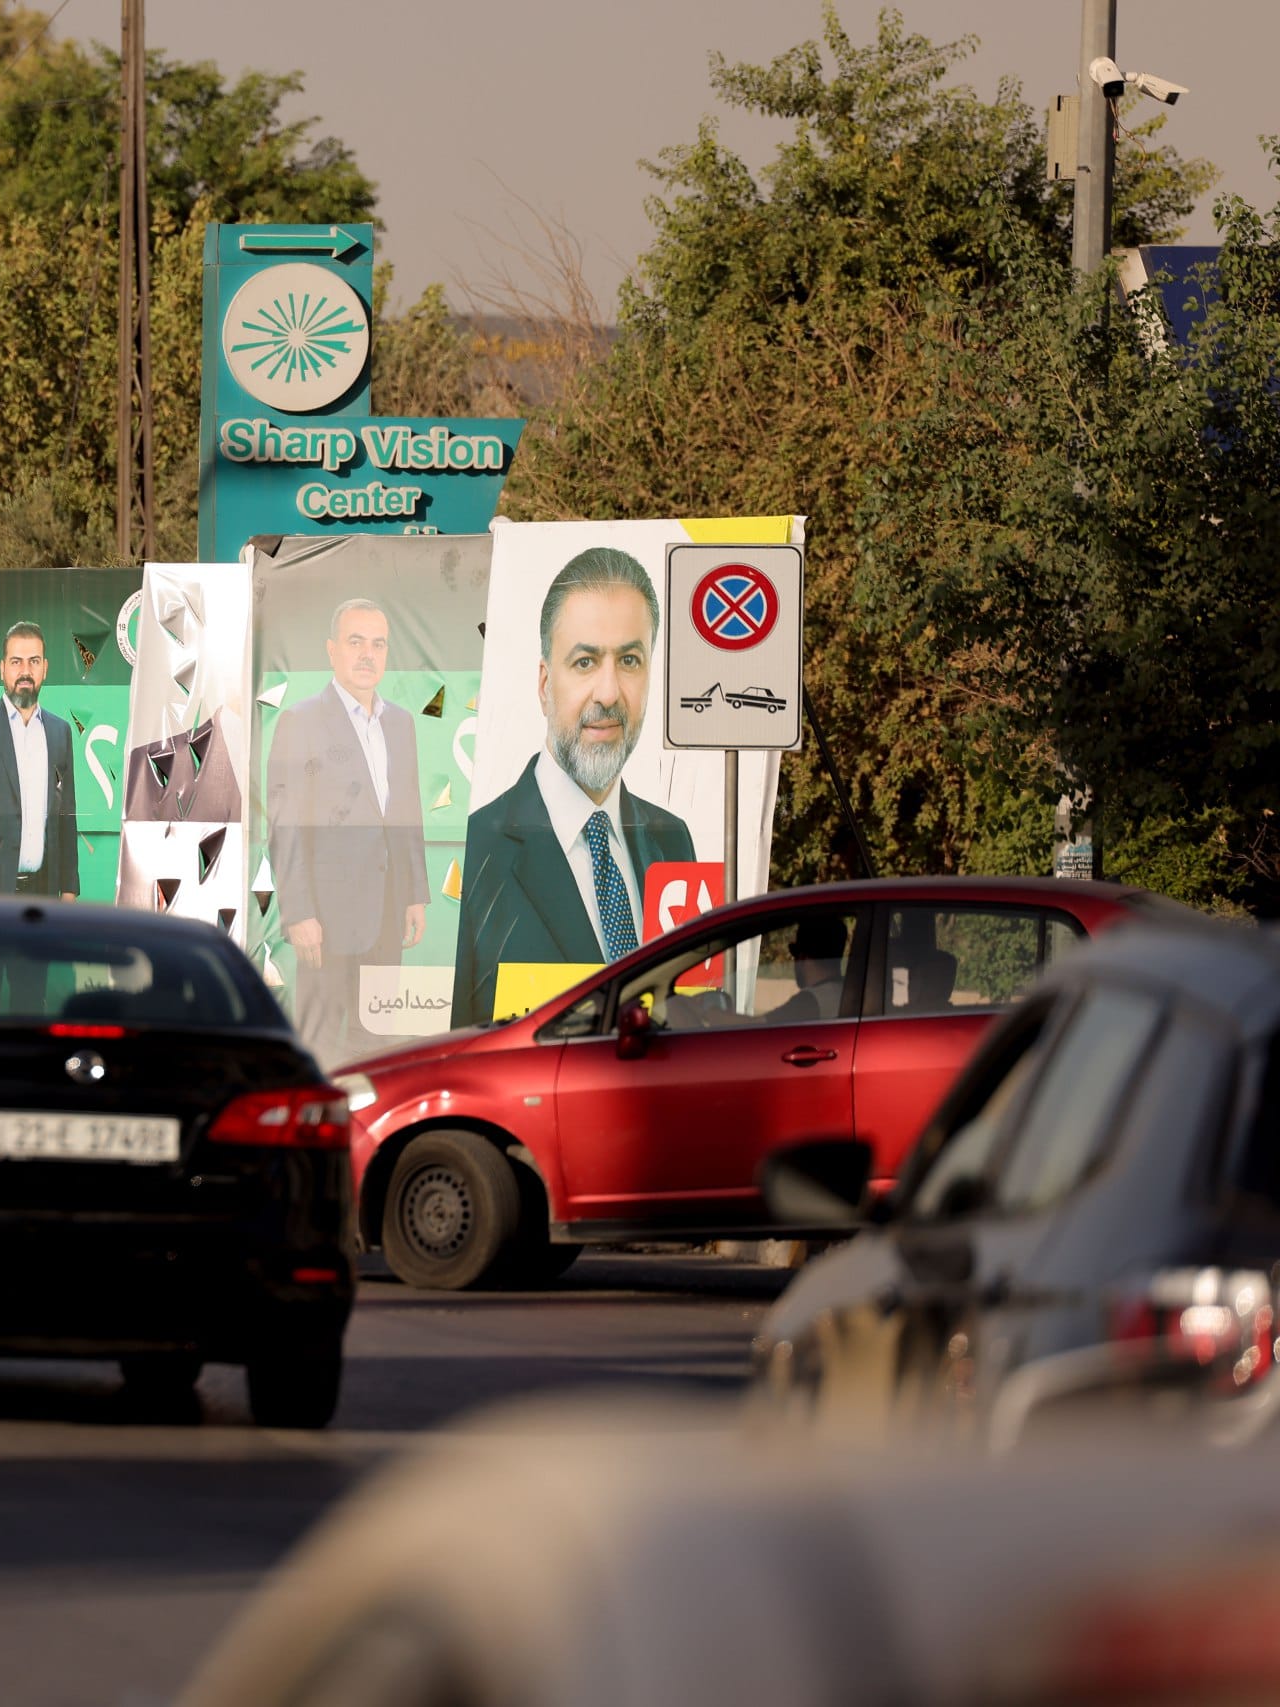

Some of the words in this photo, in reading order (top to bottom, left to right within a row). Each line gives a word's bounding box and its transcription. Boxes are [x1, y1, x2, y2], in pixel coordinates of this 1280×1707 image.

[222, 419, 356, 471] Sharp
[361, 425, 503, 469] Vision
[296, 481, 422, 518] Center
